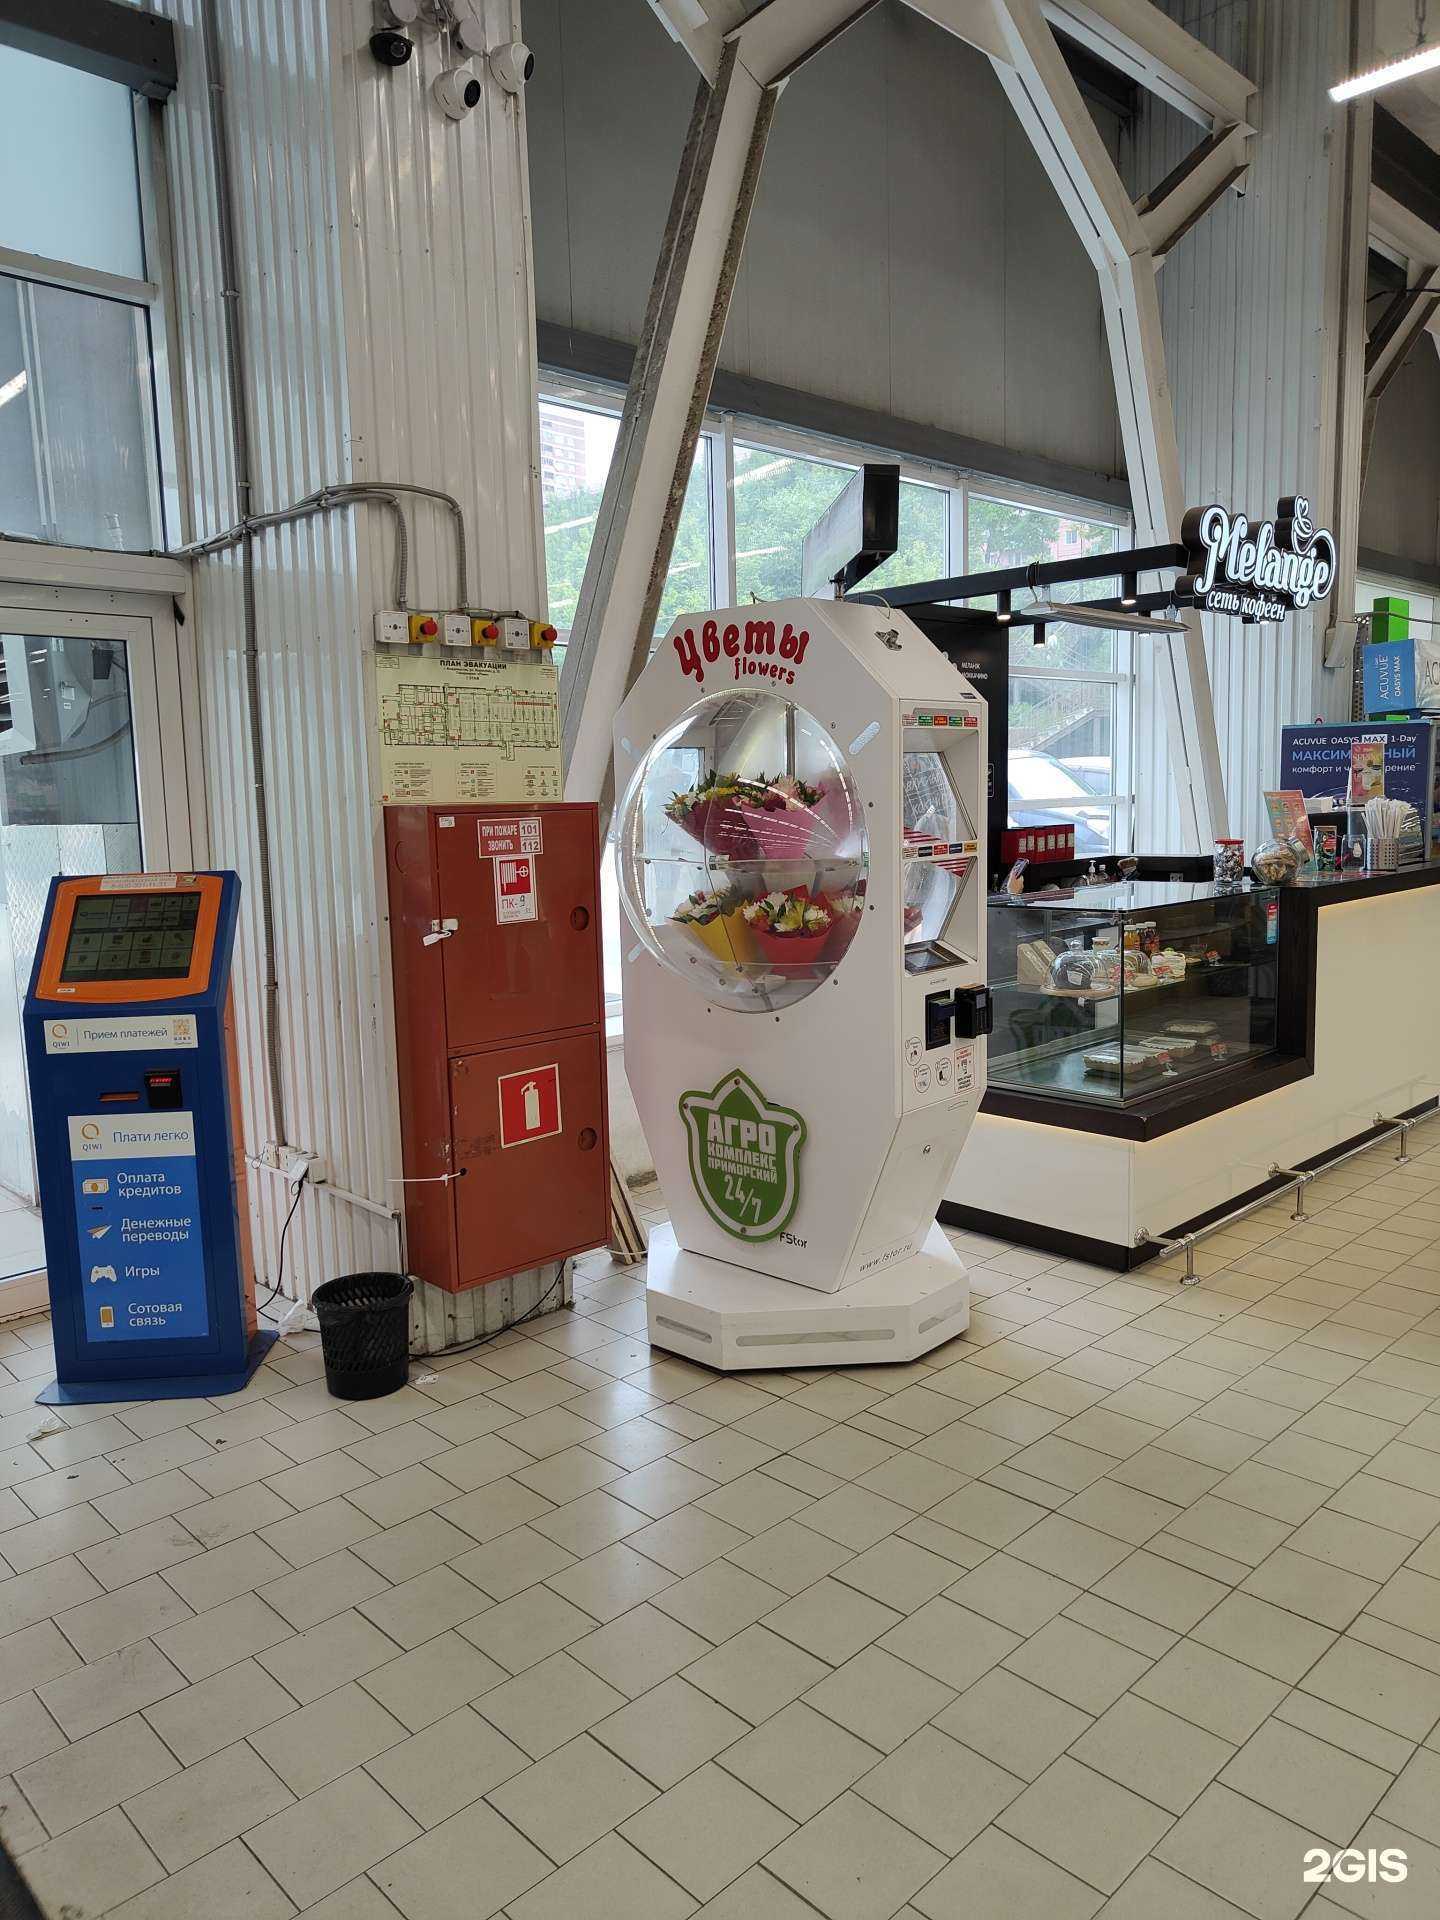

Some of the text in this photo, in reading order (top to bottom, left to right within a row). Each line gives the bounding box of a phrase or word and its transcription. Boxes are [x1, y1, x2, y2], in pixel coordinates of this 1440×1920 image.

[1194, 504, 1336, 607] Melange
[1208, 590, 1286, 621] сеть кофеен
[463, 661, 507, 670] ЭВАКУАЦИИ
[734, 657, 796, 685] flowers
[1292, 734, 1417, 746] ACUVUE OASYS MAX 1-Day
[1292, 765, 1333, 774] комфорт
[482, 824, 538, 837] ПРИ ПОЖАРЕ 101
[488, 840, 540, 851] ЗВОНИТЬ 112
[84, 1025, 168, 1041] Прием платежей
[53, 1041, 70, 1049] QIWI
[113, 1130, 189, 1143] Плати легко
[707, 1113, 777, 1154] АГРО
[82, 1143, 103, 1152] QIWI
[707, 1142, 777, 1170] КОМПЛЕКС
[708, 1156, 778, 1185] ПРИМОРСКИЙ
[117, 1172, 165, 1184] Оплата
[118, 1185, 182, 1199] кредитов
[725, 1173, 762, 1224] 24/7
[121, 1217, 192, 1231] Денежные
[122, 1230, 189, 1244] переводы
[780, 1231, 809, 1249] FStor
[125, 1265, 160, 1279] Игры
[128, 1302, 183, 1315] Сотовая
[129, 1316, 166, 1327] связь
